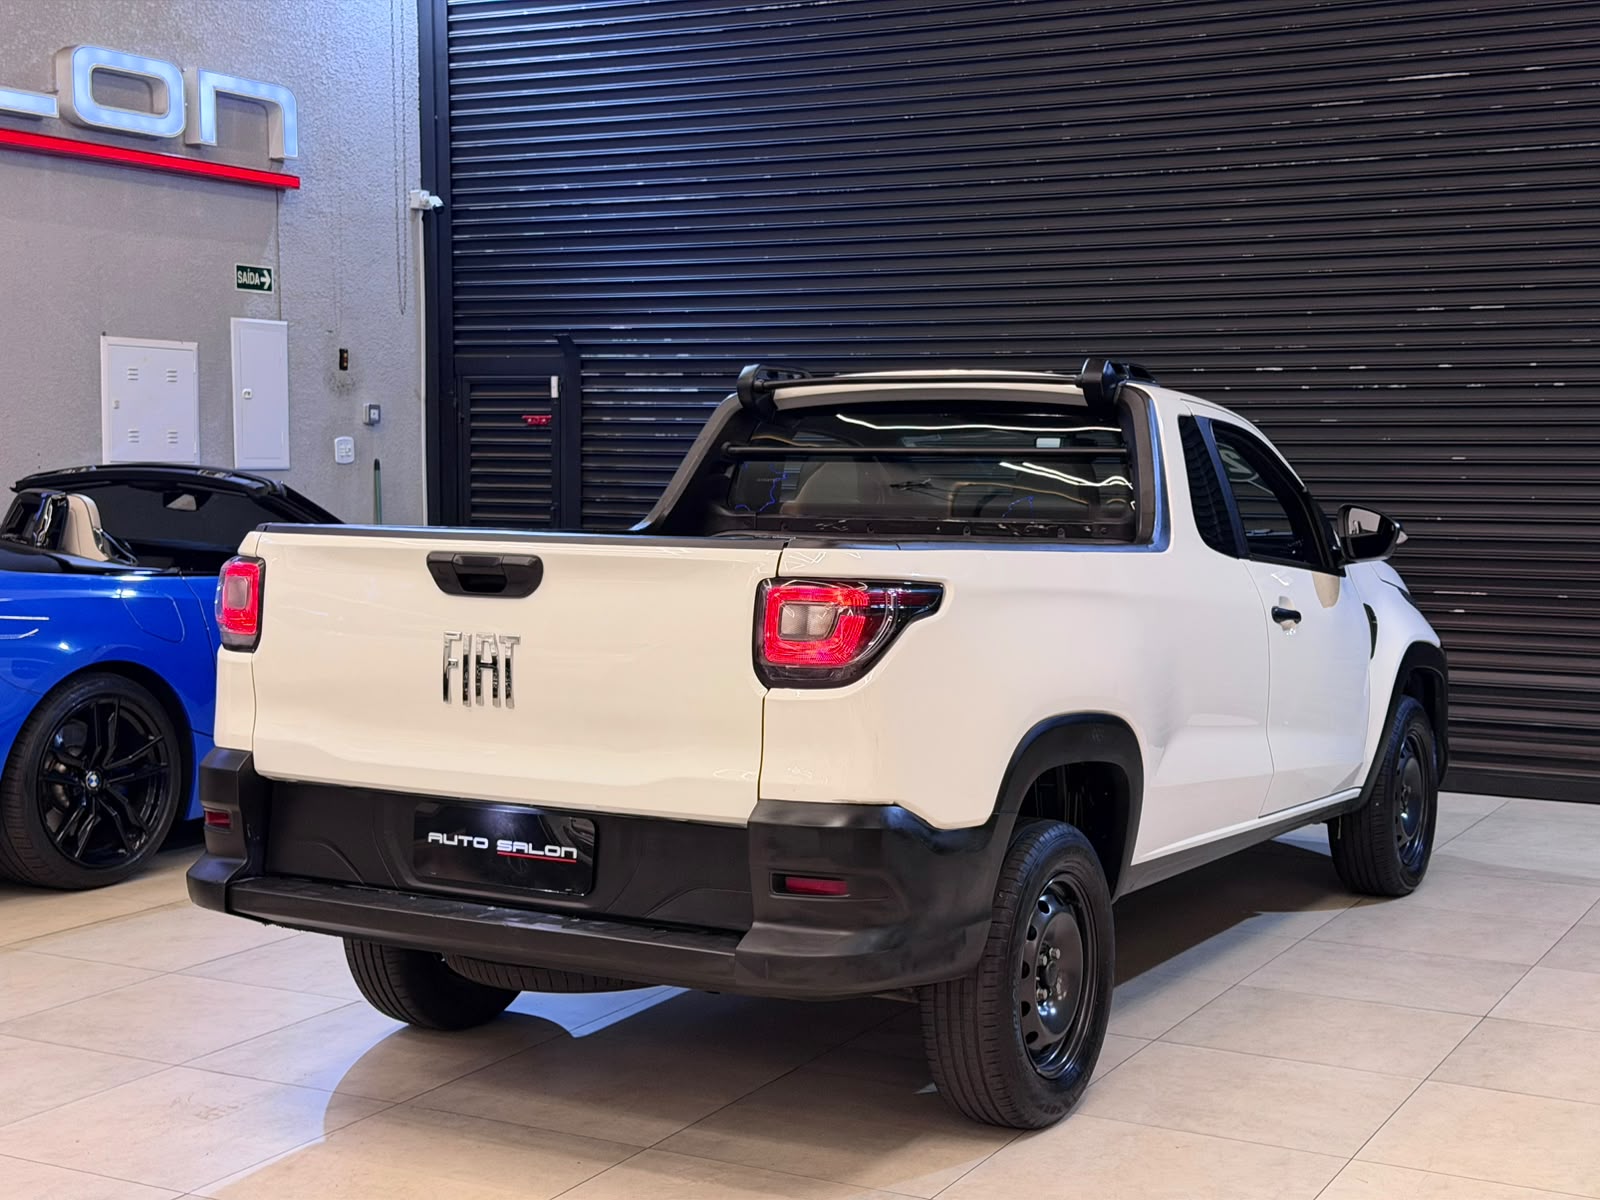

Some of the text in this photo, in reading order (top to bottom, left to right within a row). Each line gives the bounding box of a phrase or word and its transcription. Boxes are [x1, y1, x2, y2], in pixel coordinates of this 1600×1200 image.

[237, 268, 260, 286] SAÍDA
[443, 631, 521, 708] FIAT
[427, 832, 578, 860] AUTO SALON
